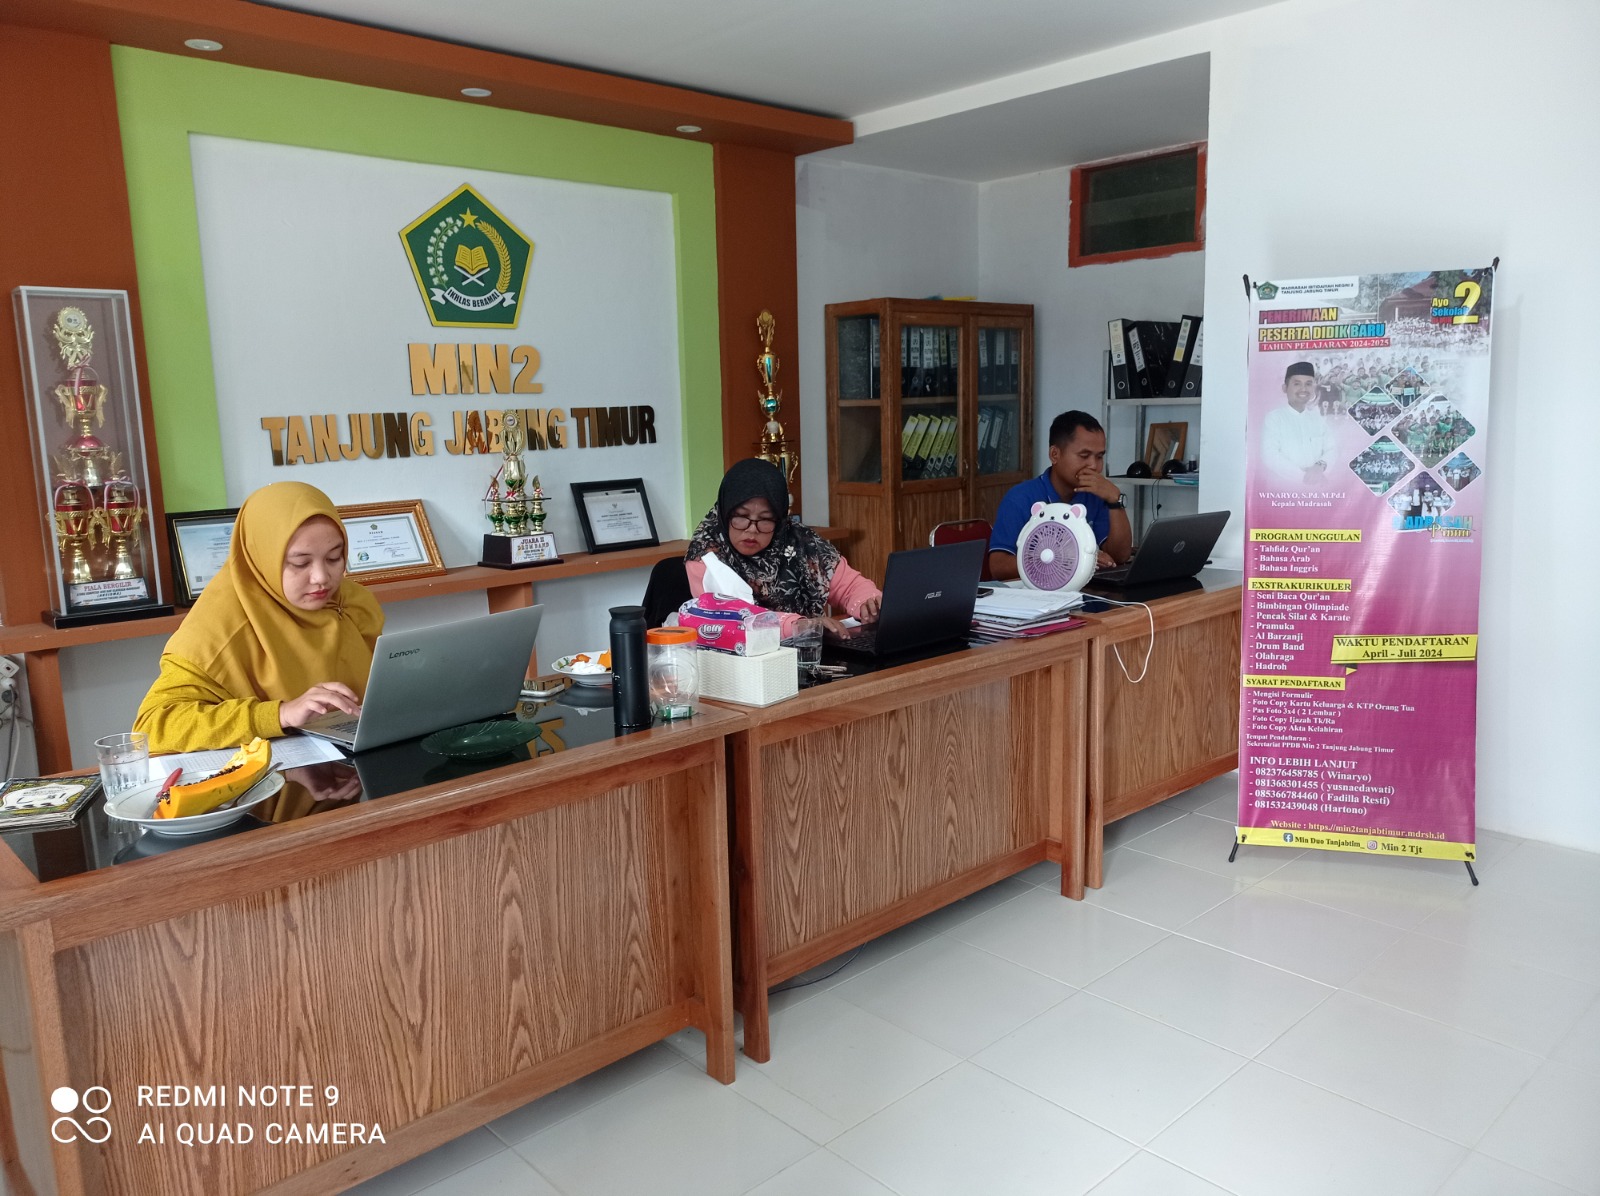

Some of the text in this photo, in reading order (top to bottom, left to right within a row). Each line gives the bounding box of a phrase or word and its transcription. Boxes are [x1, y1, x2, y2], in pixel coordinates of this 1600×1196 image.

[447, 289, 500, 308] IKHLAS BERAMAL
[1431, 297, 1449, 307] Ayo
[1454, 281, 1481, 325] 2
[1259, 307, 1338, 324] PENERIMAAN
[1258, 323, 1386, 342] PESERTA DIDIK BARU
[1262, 339, 1389, 351] TAHUN PELAJARAN 2024-2025
[407, 343, 544, 395] MIN2
[261, 412, 434, 466] TANJUNG
[570, 405, 657, 448] TIMUR
[1271, 500, 1295, 508] Kepala
[1255, 532, 1360, 541] PROGRAM UNGGULAN
[1290, 564, 1319, 573] Inggris
[1251, 581, 1351, 590] EXSTRAKURIKULER
[1256, 592, 1331, 601] Seni Baca Qur'an
[1256, 602, 1350, 612] Bimbingan Olimpiade
[1256, 612, 1286, 620] Pencak
[1288, 612, 1307, 620] Silat
[1320, 613, 1351, 621] Karate
[1256, 622, 1295, 630] Pramuka
[1255, 632, 1303, 642] Al Barzanji
[1336, 637, 1470, 646] WAKTU PENDAFTARAN
[1255, 642, 1305, 651] Drum Band
[389, 648, 421, 659] Lenovo
[1255, 652, 1295, 661] Olahraga
[1362, 649, 1388, 660] April
[1397, 649, 1416, 658] Juli
[1420, 649, 1443, 657] 2024
[1246, 678, 1341, 688] SYARAT PENDAFTARAN
[1252, 690, 1314, 699] Mengisi Formulir
[1269, 699, 1288, 707] Copy
[1312, 701, 1346, 709] Keluarga
[1356, 702, 1374, 710] KTP
[1375, 703, 1399, 712] Orang
[1400, 704, 1415, 712] Tua
[1308, 709, 1336, 717] Lembar
[1269, 715, 1287, 724] Copy
[1289, 716, 1312, 724] Ijazah
[1314, 717, 1336, 725] Tk/Ra
[1269, 724, 1287, 732] Copy
[1307, 725, 1343, 733] Kelahiran
[1322, 743, 1348, 751] Tanjung
[1348, 745, 1372, 753] Jabung
[1250, 756, 1358, 769] INFO LEBIH LANJUT
[1255, 767, 1319, 778] 082376458785
[1327, 770, 1372, 782] Winaryo)
[1255, 778, 1319, 789] 081368301455
[1254, 789, 1318, 800] 085366784460
[1327, 793, 1360, 803] Fadilla
[1362, 795, 1390, 806] Resti)
[1254, 800, 1367, 816] 081532439048 (Hartono)
[1270, 819, 1302, 829] Website
[1295, 836, 1309, 844] Min
[1381, 842, 1423, 855] Min 2 Tjt
